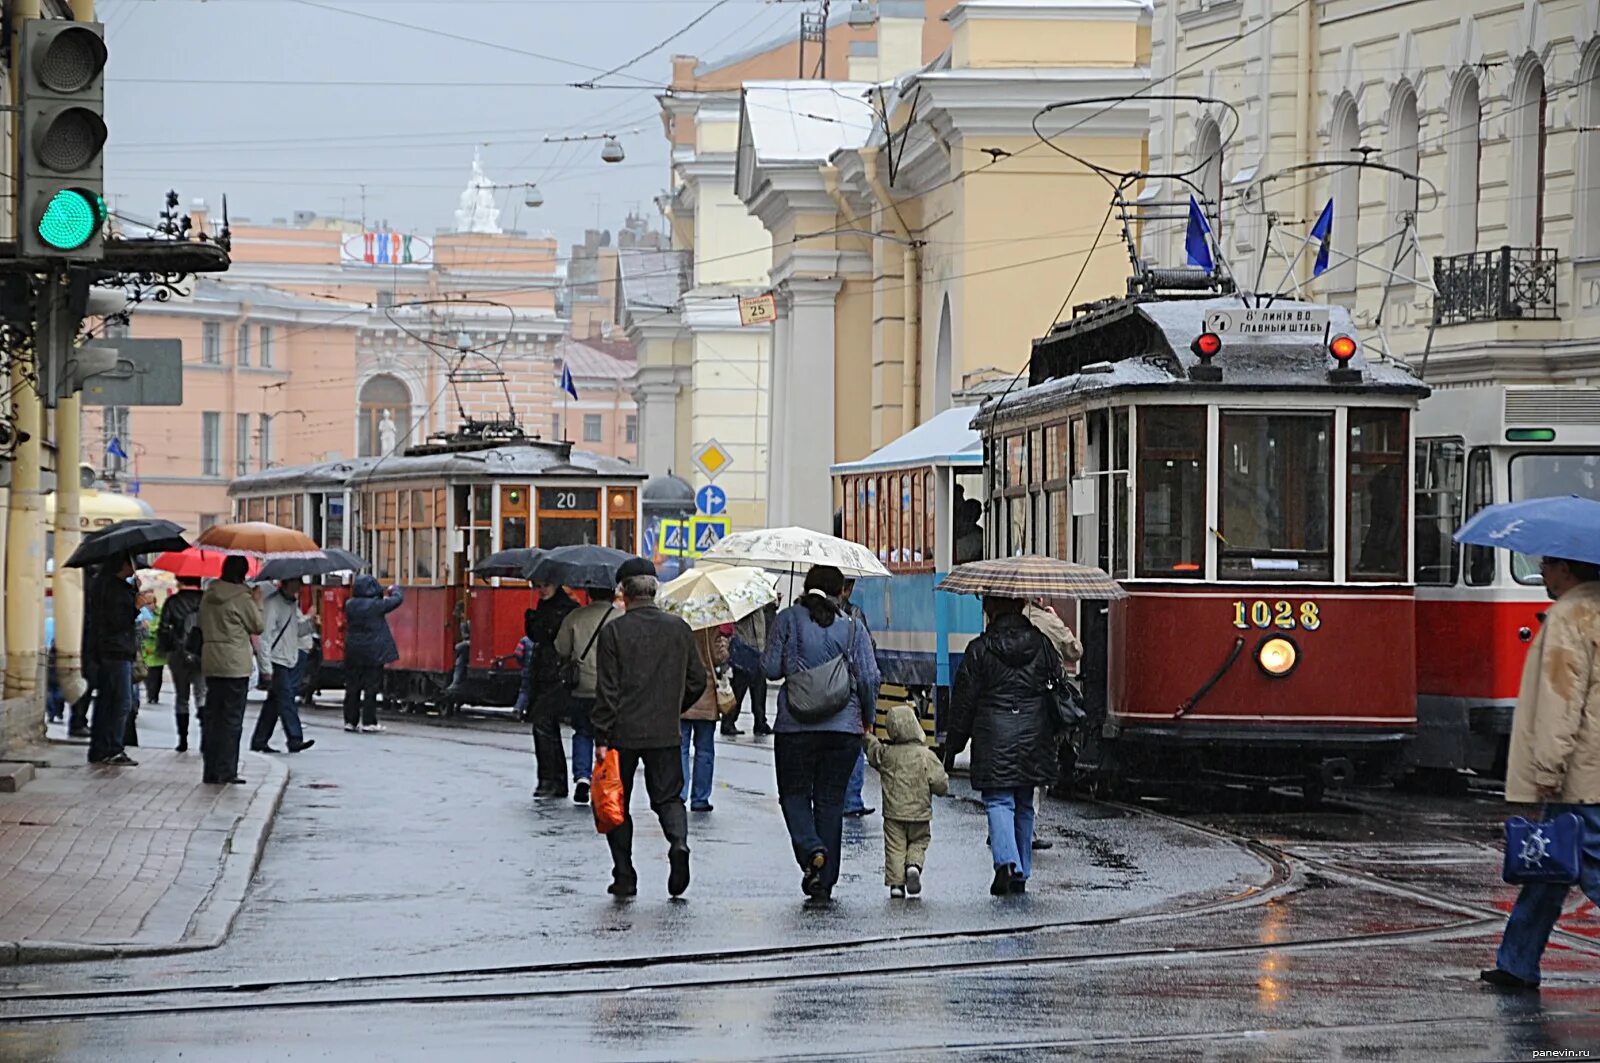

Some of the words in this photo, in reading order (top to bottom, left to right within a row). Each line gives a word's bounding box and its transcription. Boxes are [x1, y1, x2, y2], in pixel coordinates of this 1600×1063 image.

[750, 305, 765, 316] 25
[557, 492, 576, 508] 20
[1232, 600, 1321, 631] 1028
